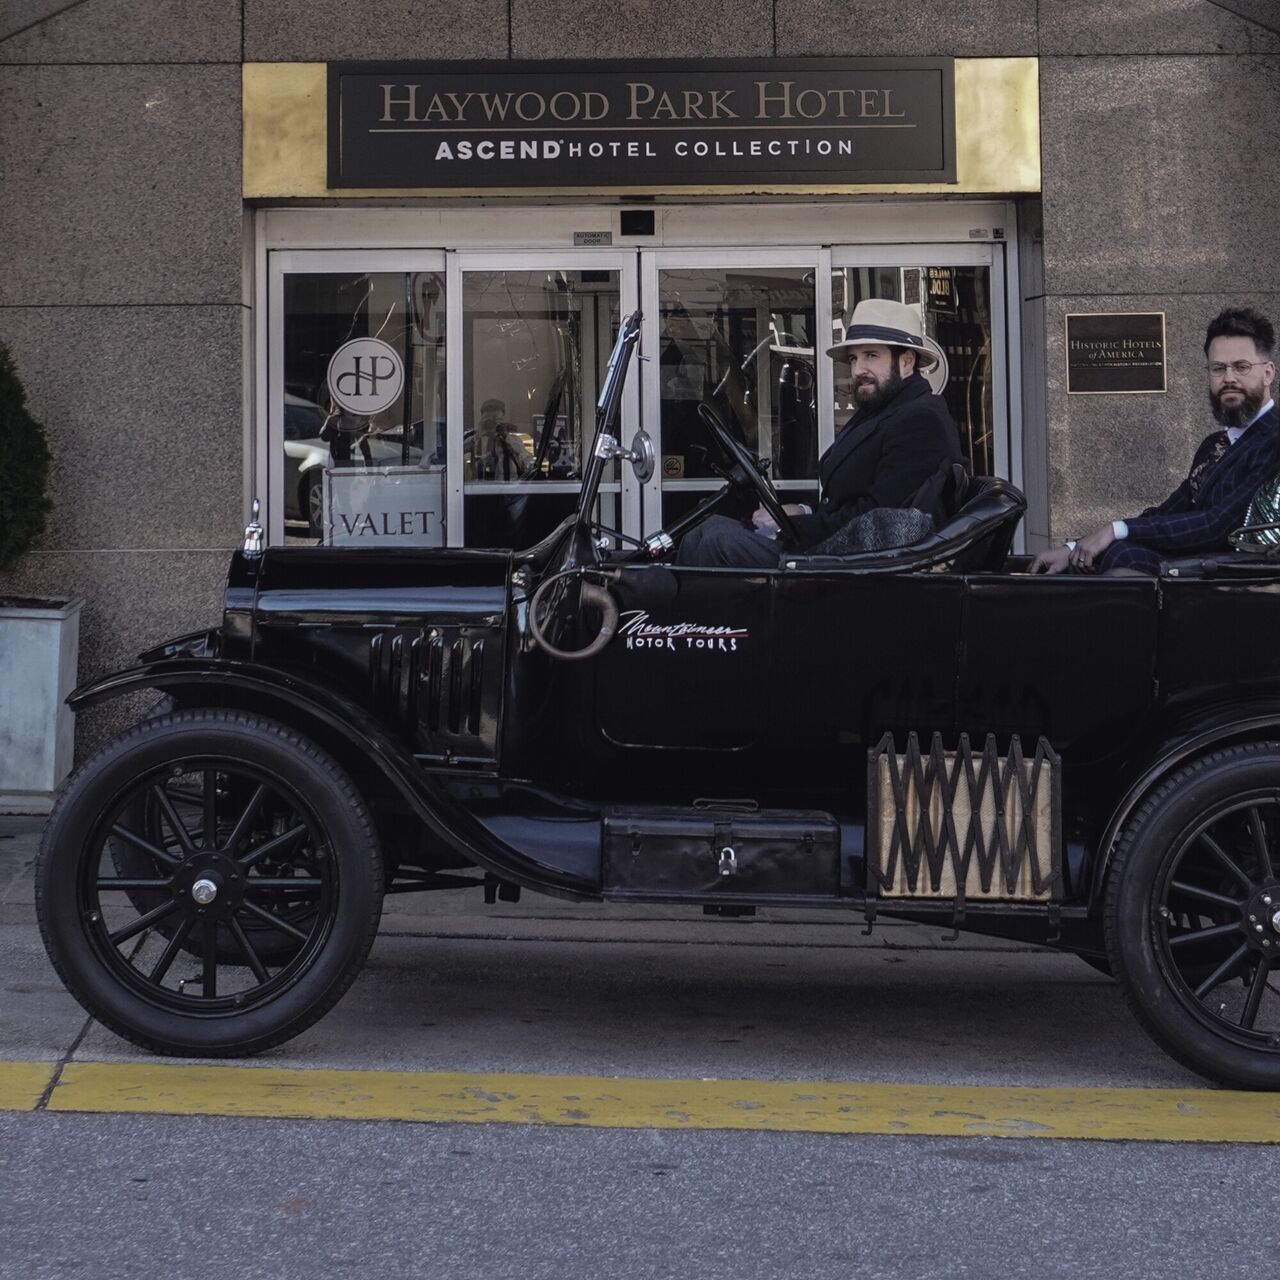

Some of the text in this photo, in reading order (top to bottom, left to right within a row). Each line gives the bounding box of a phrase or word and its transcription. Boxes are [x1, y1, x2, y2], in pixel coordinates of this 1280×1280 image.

[378, 81, 906, 122] HAYWOOD PARK HOTEL
[435, 139, 853, 161] ASCEND HOTEL COLLECTION
[1071, 339, 1162, 350] HISTORIC HOTELS
[1088, 350, 1145, 360] of AMERICA
[340, 511, 435, 537] VALET
[626, 637, 737, 652] MOTOR TOURS
